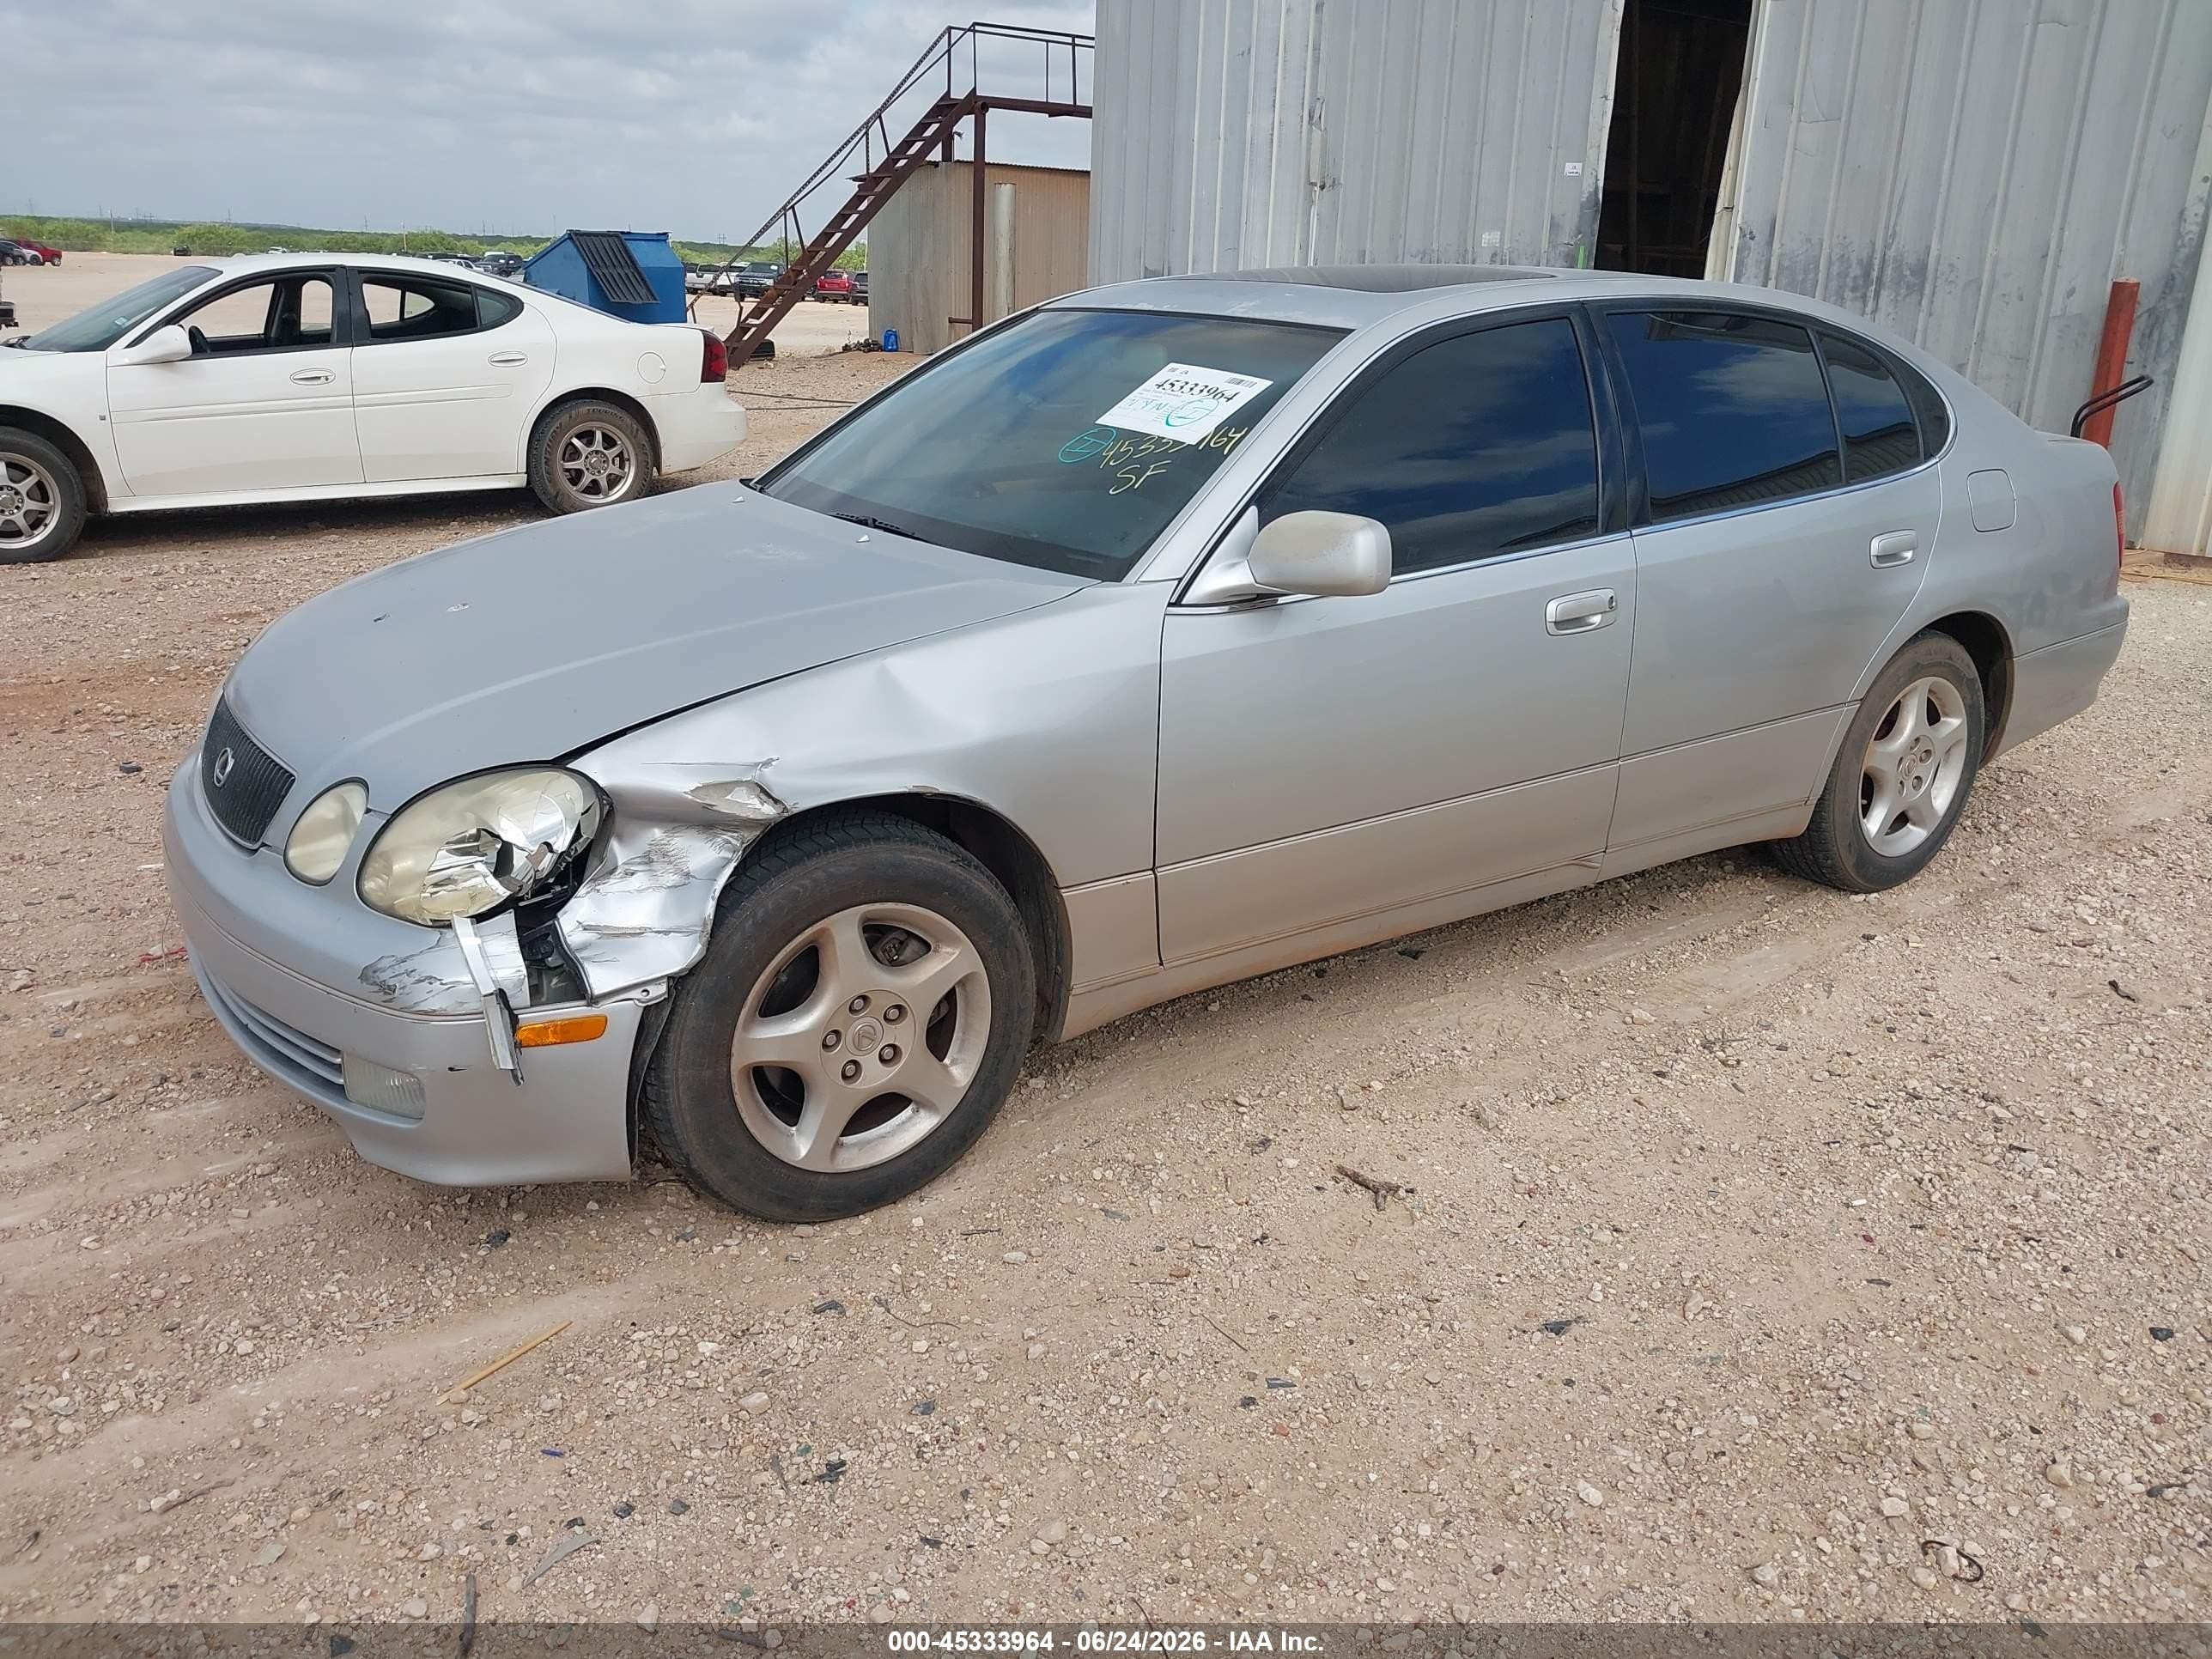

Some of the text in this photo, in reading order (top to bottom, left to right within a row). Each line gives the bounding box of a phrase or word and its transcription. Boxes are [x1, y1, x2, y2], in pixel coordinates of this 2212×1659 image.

[1155, 379, 1241, 403] 45333964
[586, 408, 626, 422] TOURING
[1109, 459, 1172, 495] SF
